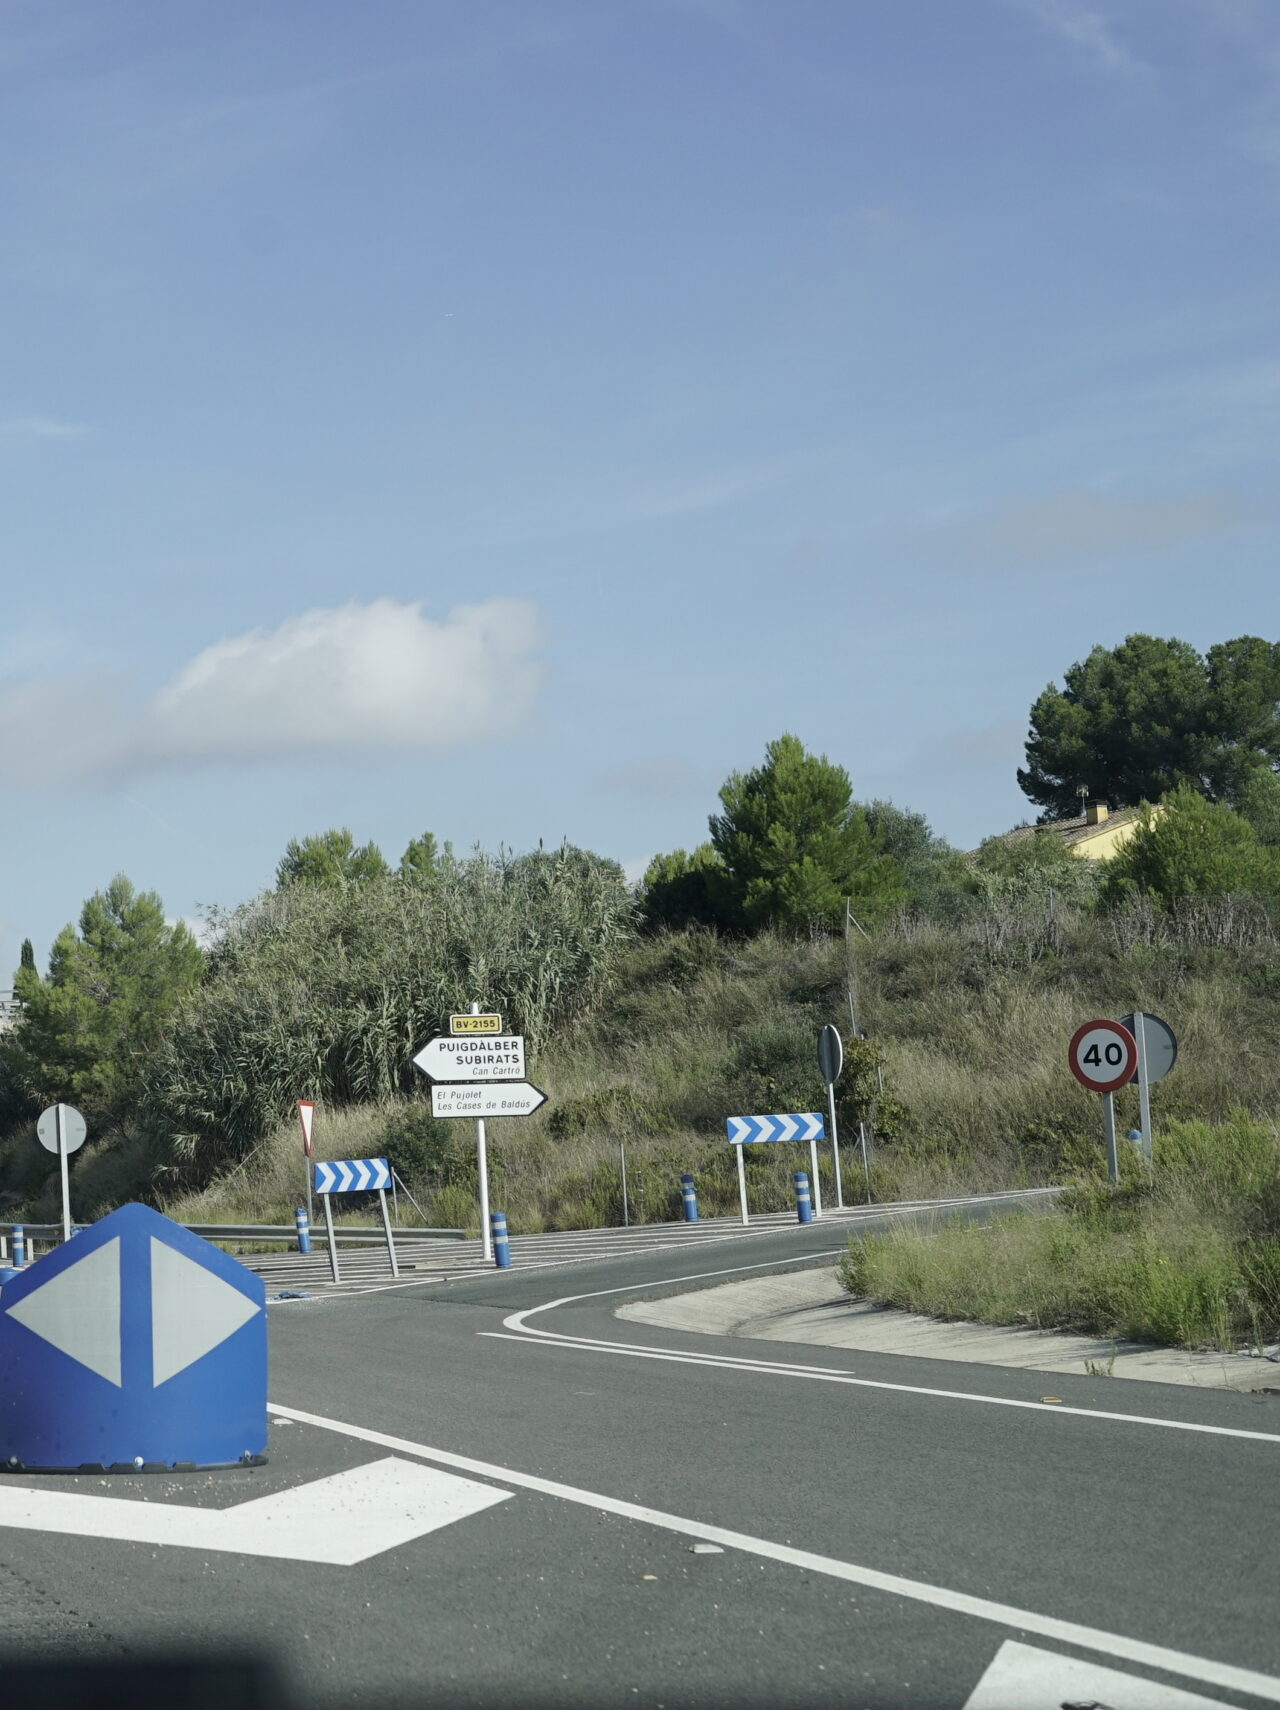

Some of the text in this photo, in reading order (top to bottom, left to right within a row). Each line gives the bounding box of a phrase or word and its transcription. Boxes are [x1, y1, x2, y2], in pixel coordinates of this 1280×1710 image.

[456, 1020, 496, 1029] BV-2155
[439, 1040, 519, 1052] PUIGDÀLBER
[456, 1054, 520, 1065] SUBIRATS
[1083, 1042, 1123, 1067] 40
[472, 1067, 489, 1076] Can
[437, 1090, 482, 1101] El Pujolet
[437, 1102, 452, 1111] Les
[456, 1101, 482, 1110] Cases
[486, 1100, 497, 1109] de
